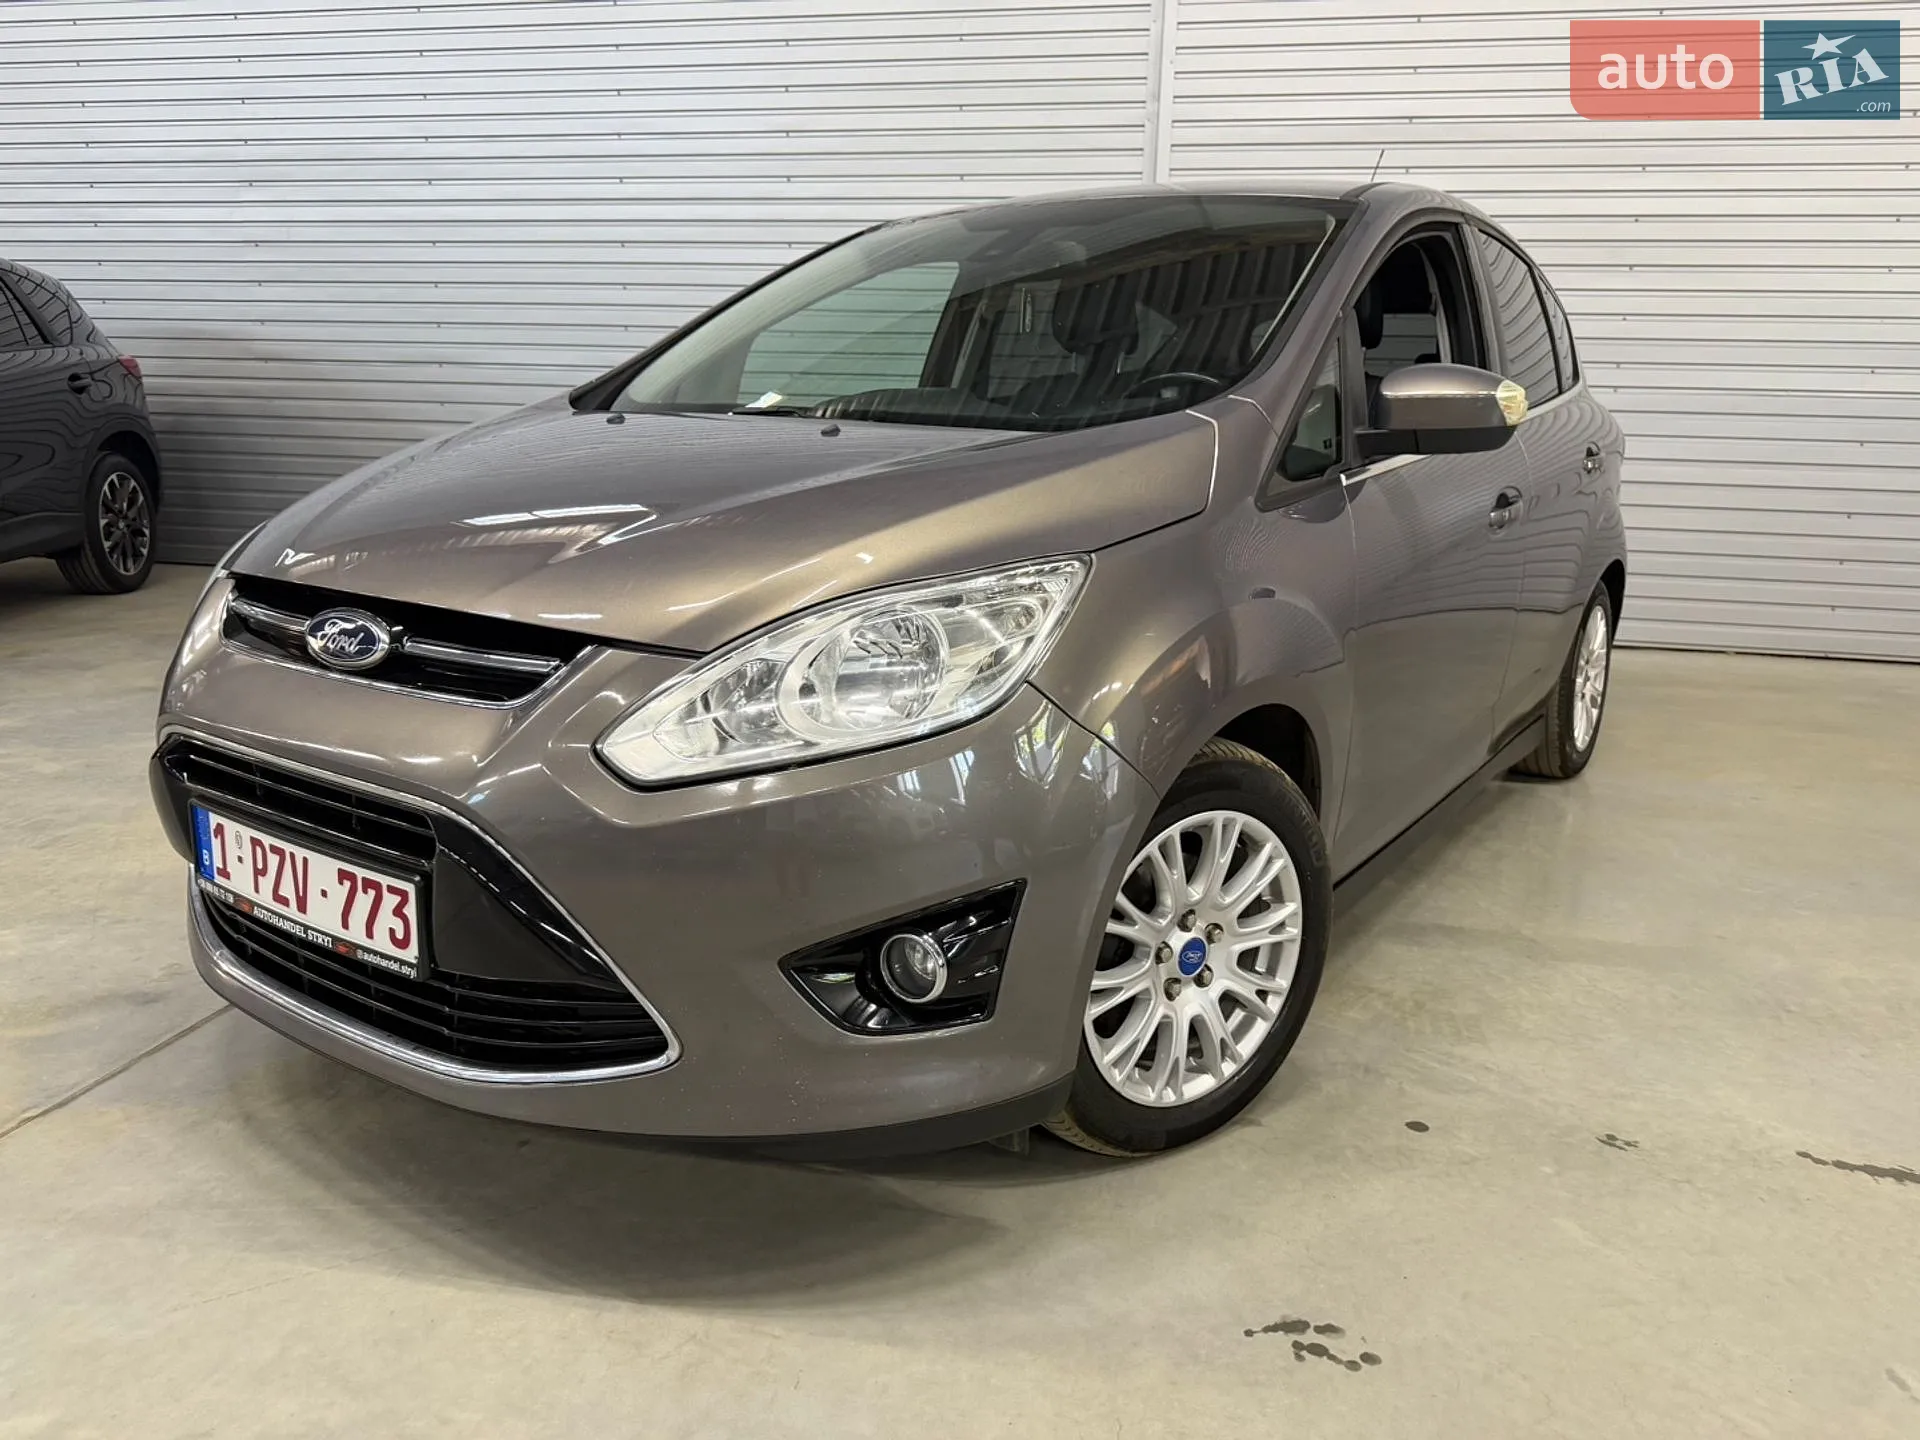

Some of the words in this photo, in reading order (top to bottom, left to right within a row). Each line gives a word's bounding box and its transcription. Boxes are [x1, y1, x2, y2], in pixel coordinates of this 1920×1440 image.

[317, 619, 366, 654] Ford
[202, 849, 210, 865] B
[253, 906, 306, 937] AUTOHANDEL
